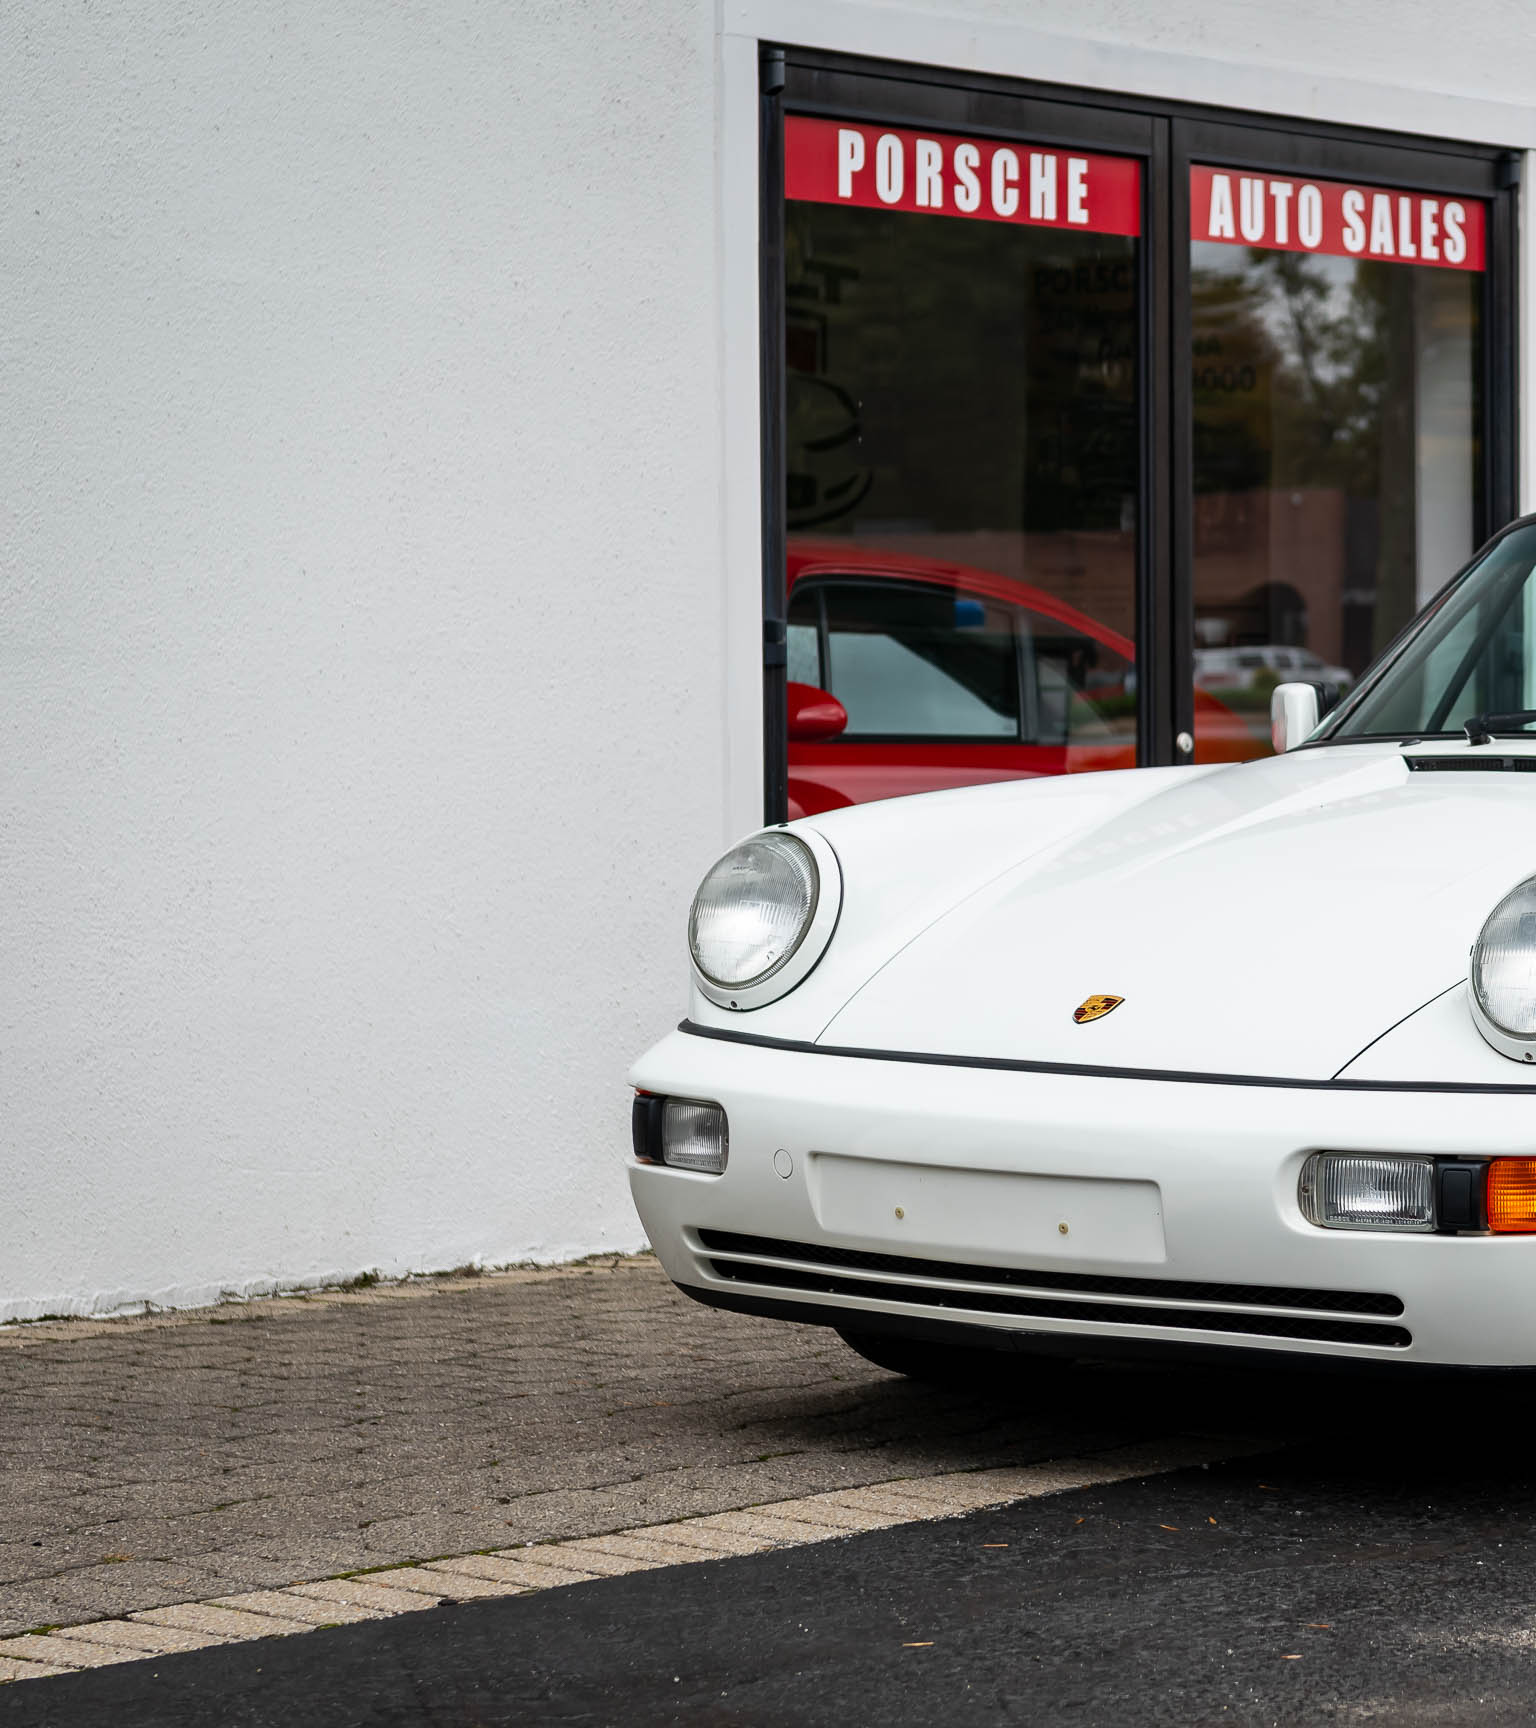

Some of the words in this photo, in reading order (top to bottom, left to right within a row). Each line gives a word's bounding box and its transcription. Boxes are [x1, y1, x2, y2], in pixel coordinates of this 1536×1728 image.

[838, 128, 1089, 225] PORSCHE
[1208, 174, 1323, 248] AUTO
[1342, 189, 1467, 264] SALES
